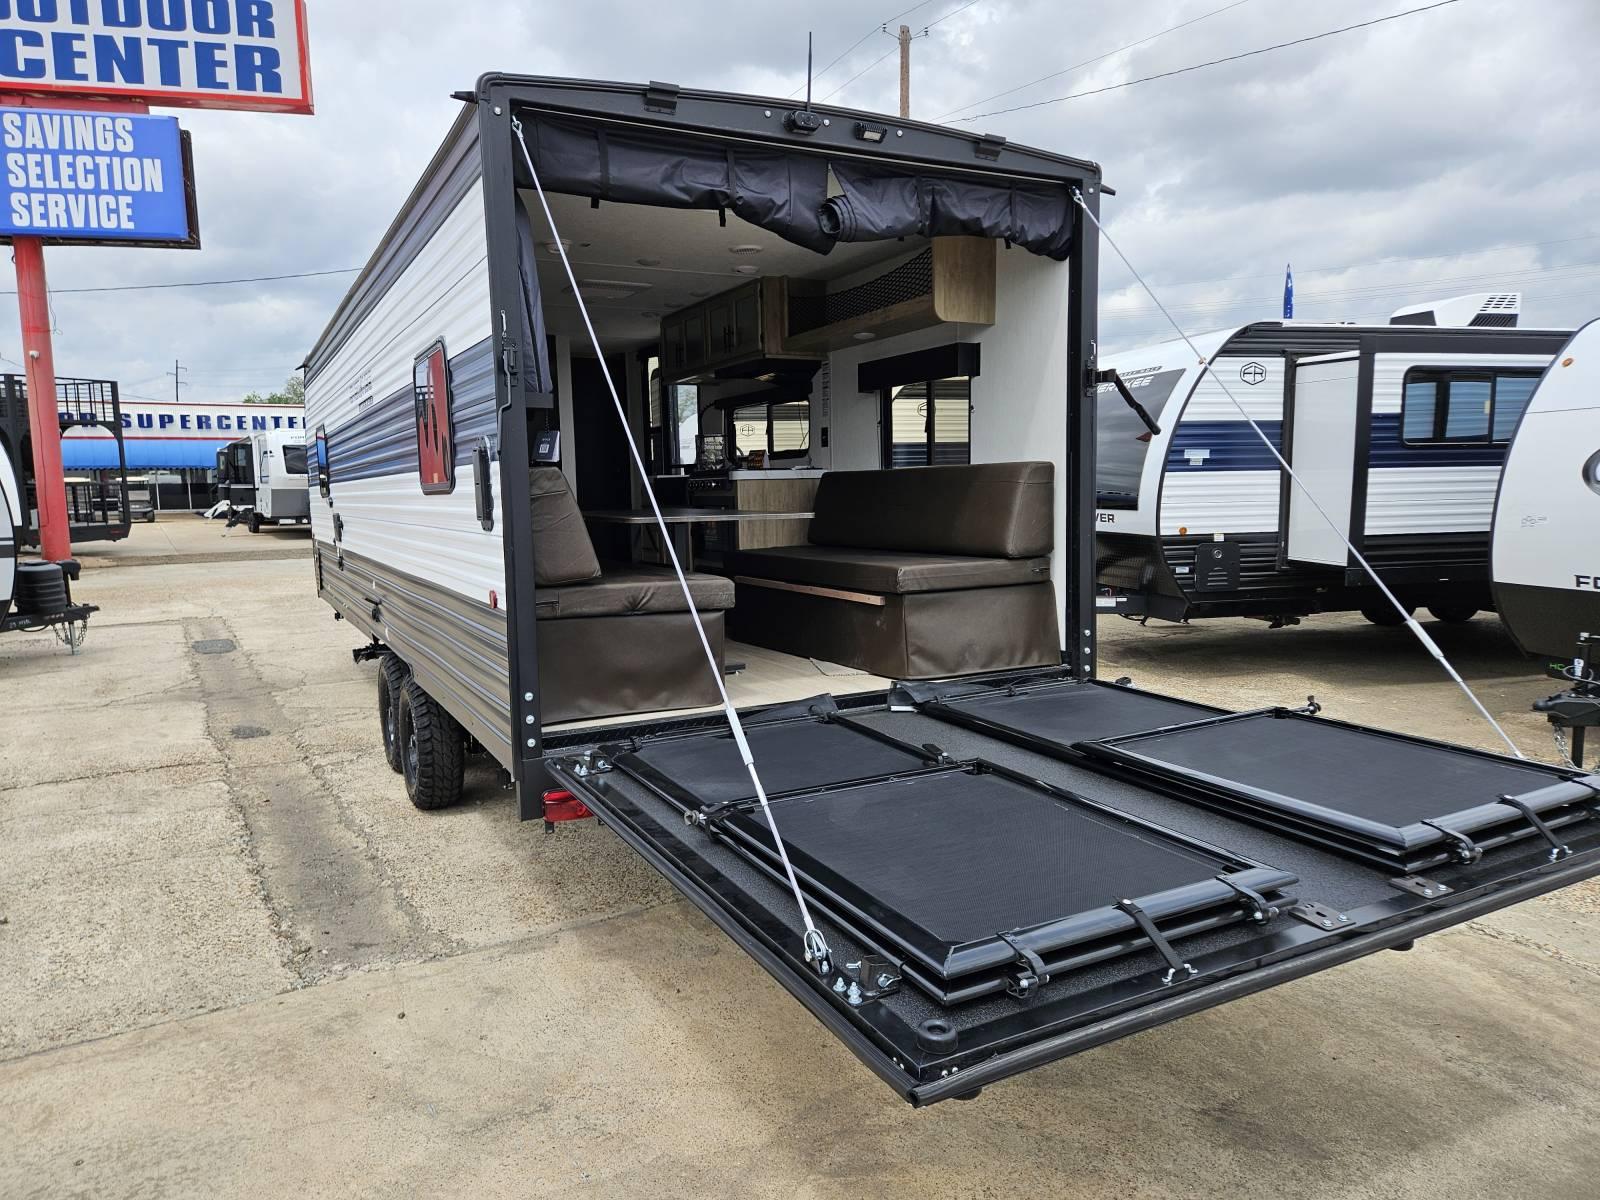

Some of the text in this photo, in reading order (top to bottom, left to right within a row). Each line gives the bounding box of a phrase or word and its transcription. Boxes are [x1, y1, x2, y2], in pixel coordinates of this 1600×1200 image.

[0, 0, 275, 38] UTDOOR
[0, 29, 282, 93] CENTER
[3, 113, 134, 152] SAVINGS
[6, 153, 163, 192] SELECTION
[10, 192, 135, 229] SERVICE
[120, 413, 305, 430] SUPERCENTE
